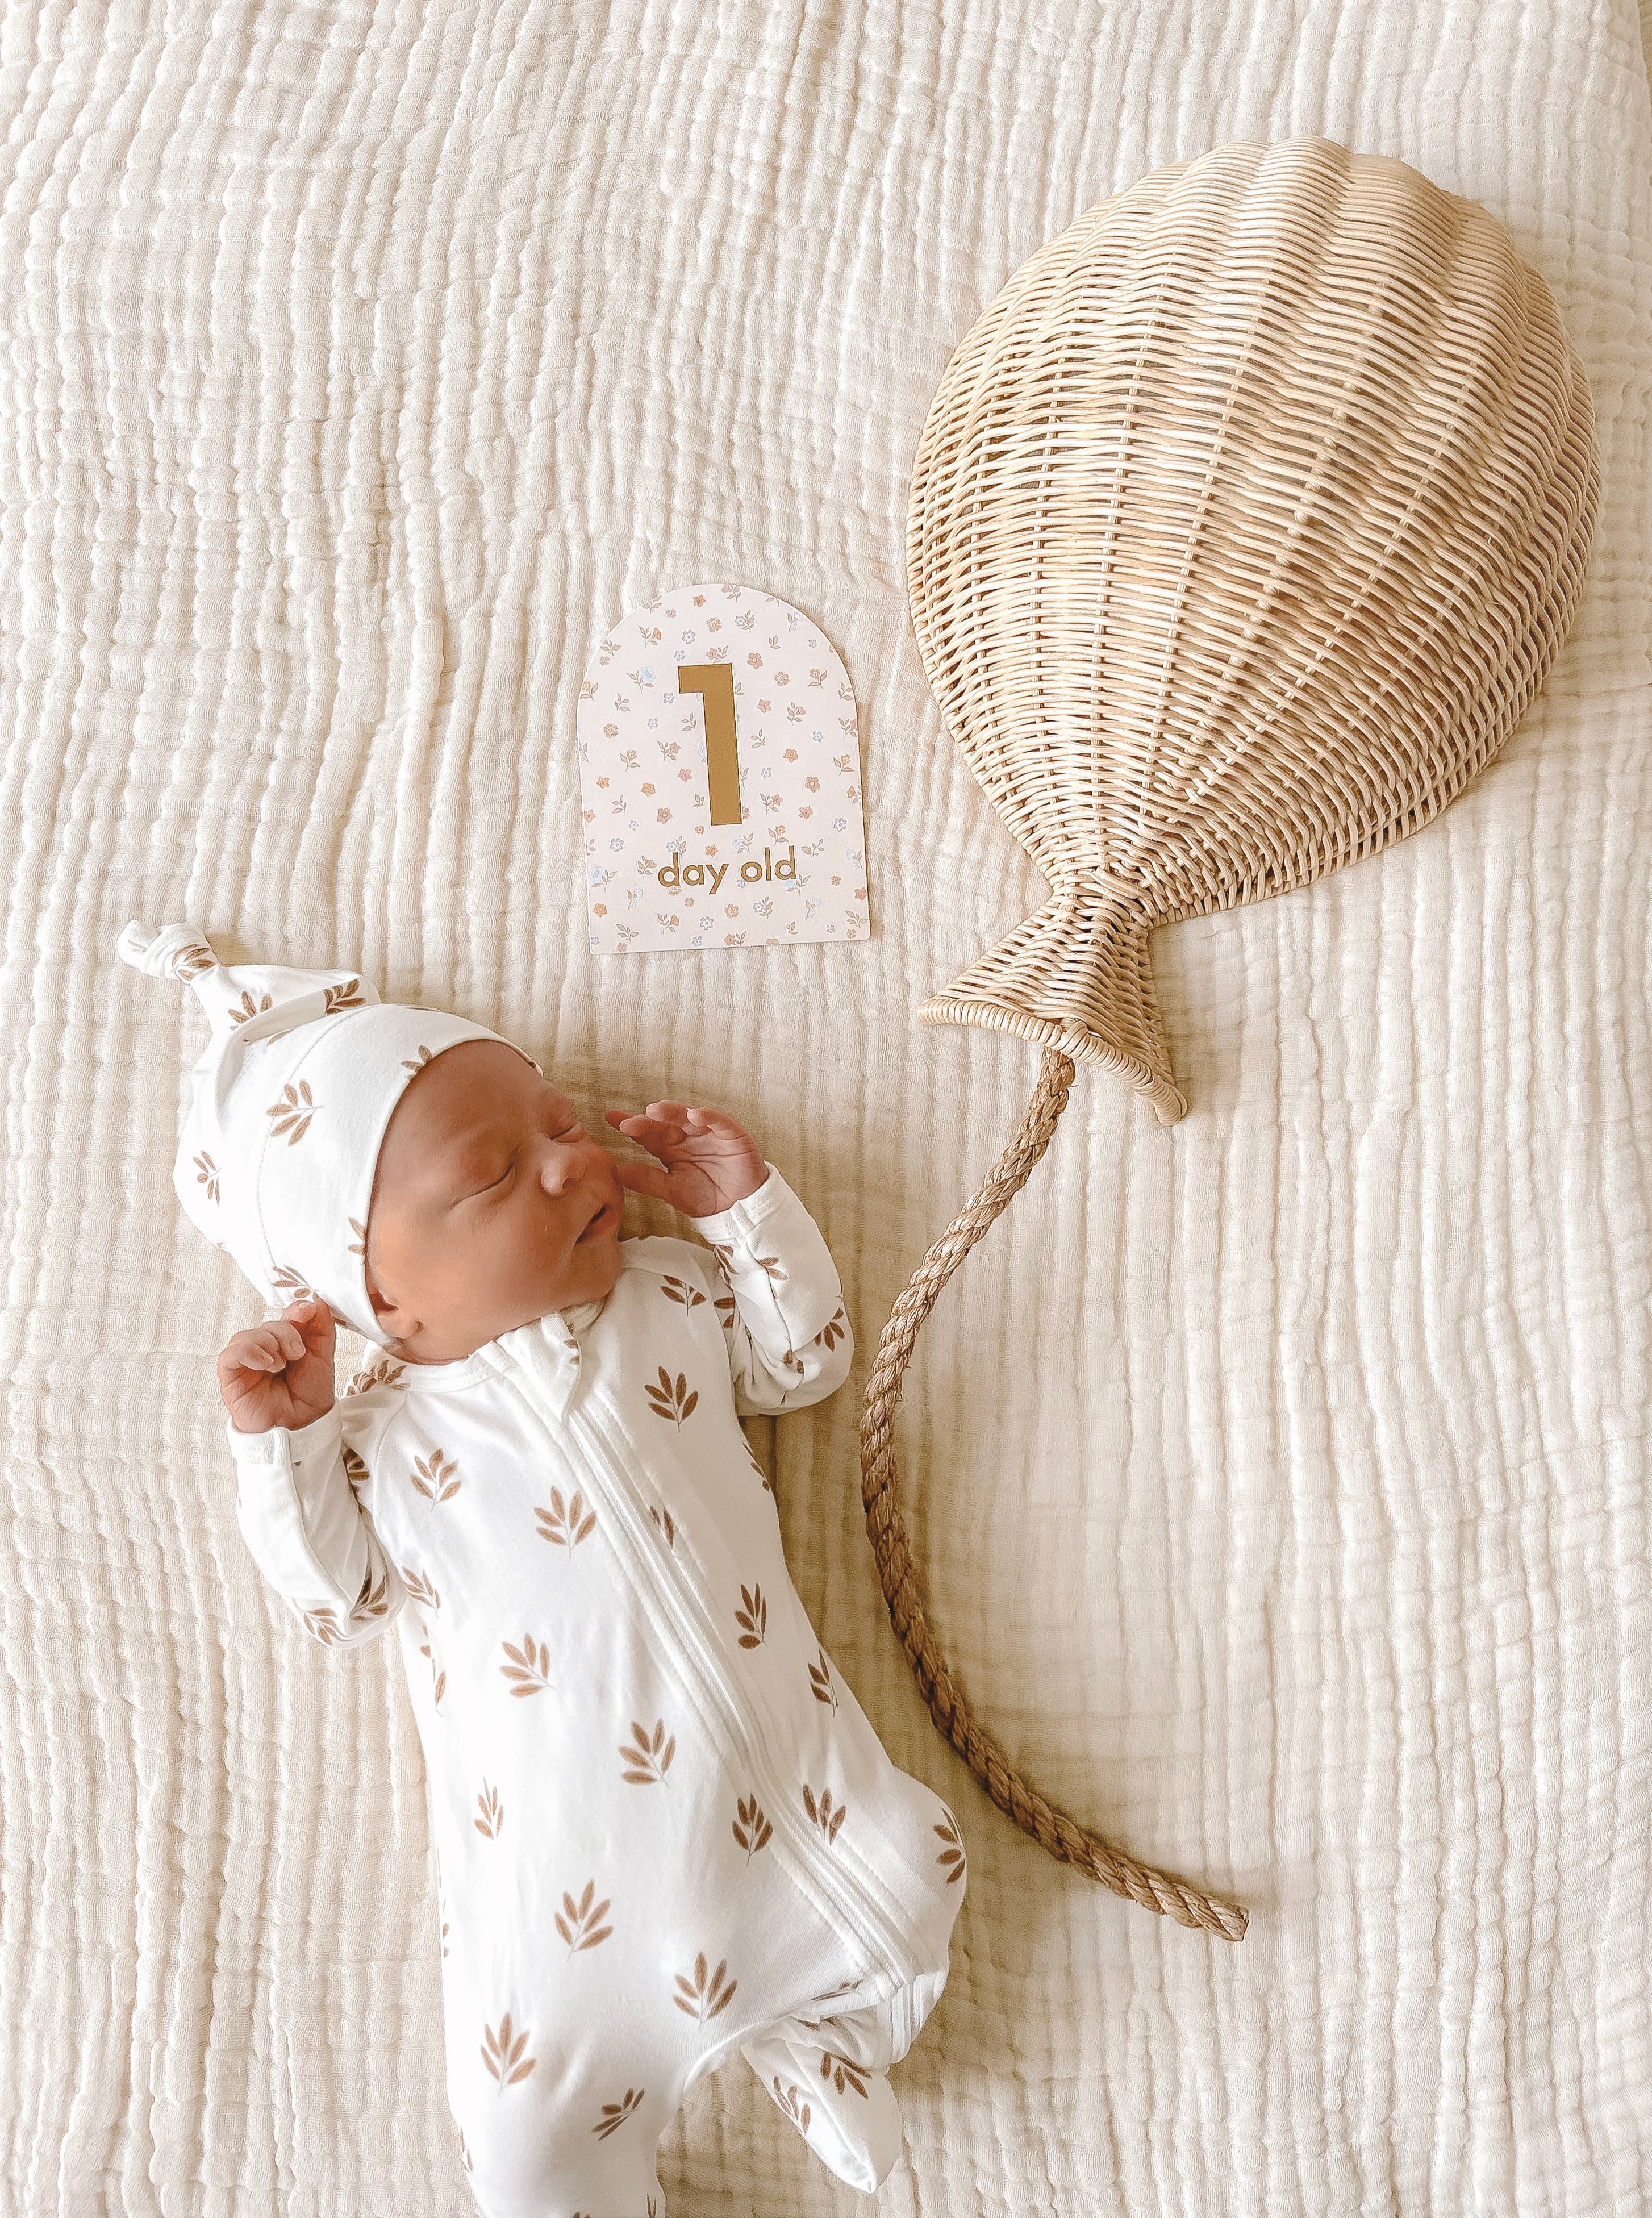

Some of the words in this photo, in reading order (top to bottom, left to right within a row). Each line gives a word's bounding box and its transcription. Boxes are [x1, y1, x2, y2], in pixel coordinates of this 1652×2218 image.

[678, 663, 742, 826] 1
[658, 852, 729, 895] day
[740, 845, 796, 882] old
